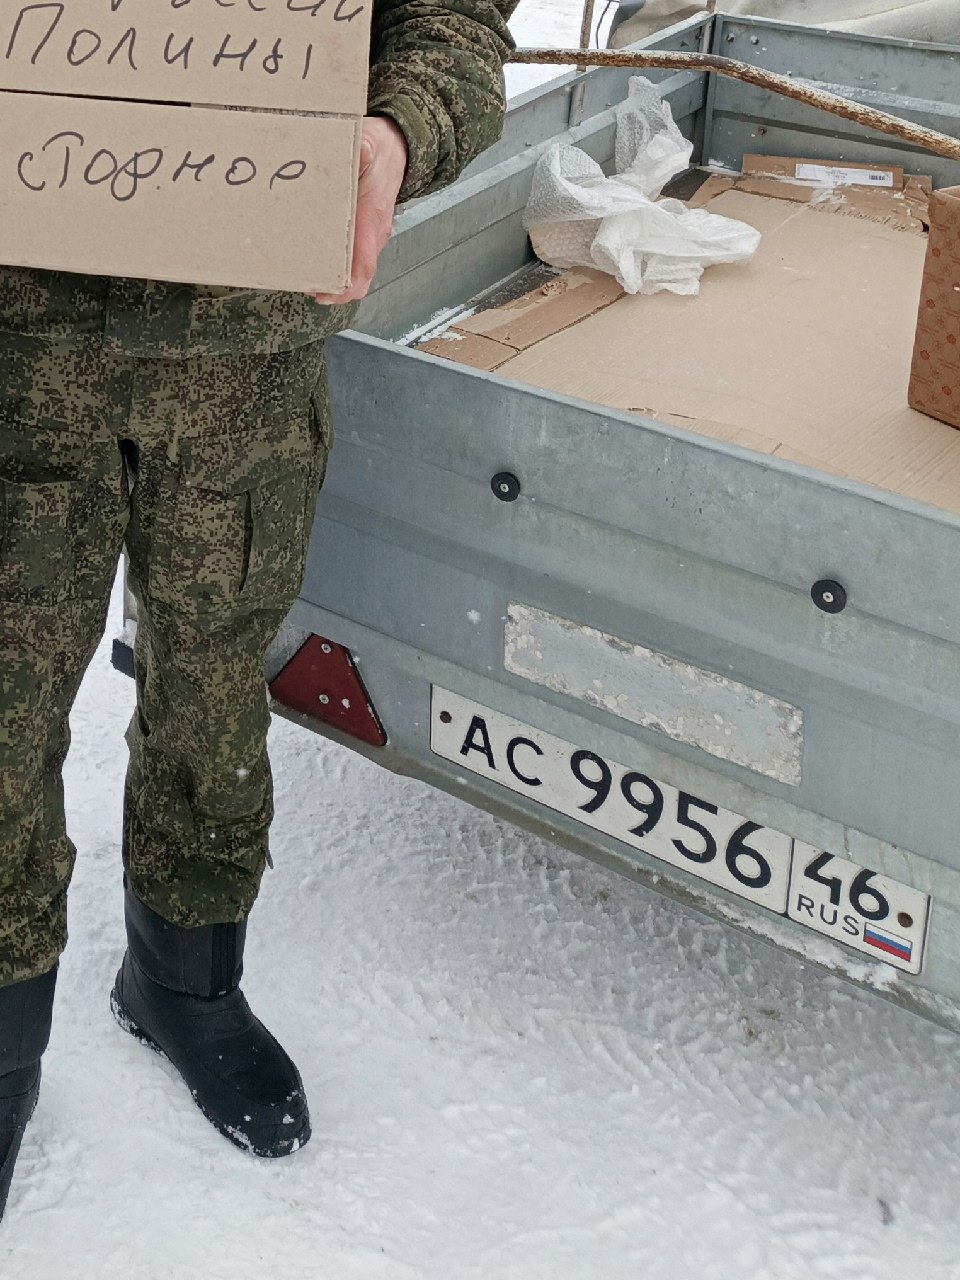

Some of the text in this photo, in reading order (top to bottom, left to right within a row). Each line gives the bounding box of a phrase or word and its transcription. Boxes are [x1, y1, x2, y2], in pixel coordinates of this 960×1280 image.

[4, 2, 313, 80] Полины
[795, 893, 860, 937] RUS
[803, 851, 891, 921] 46
